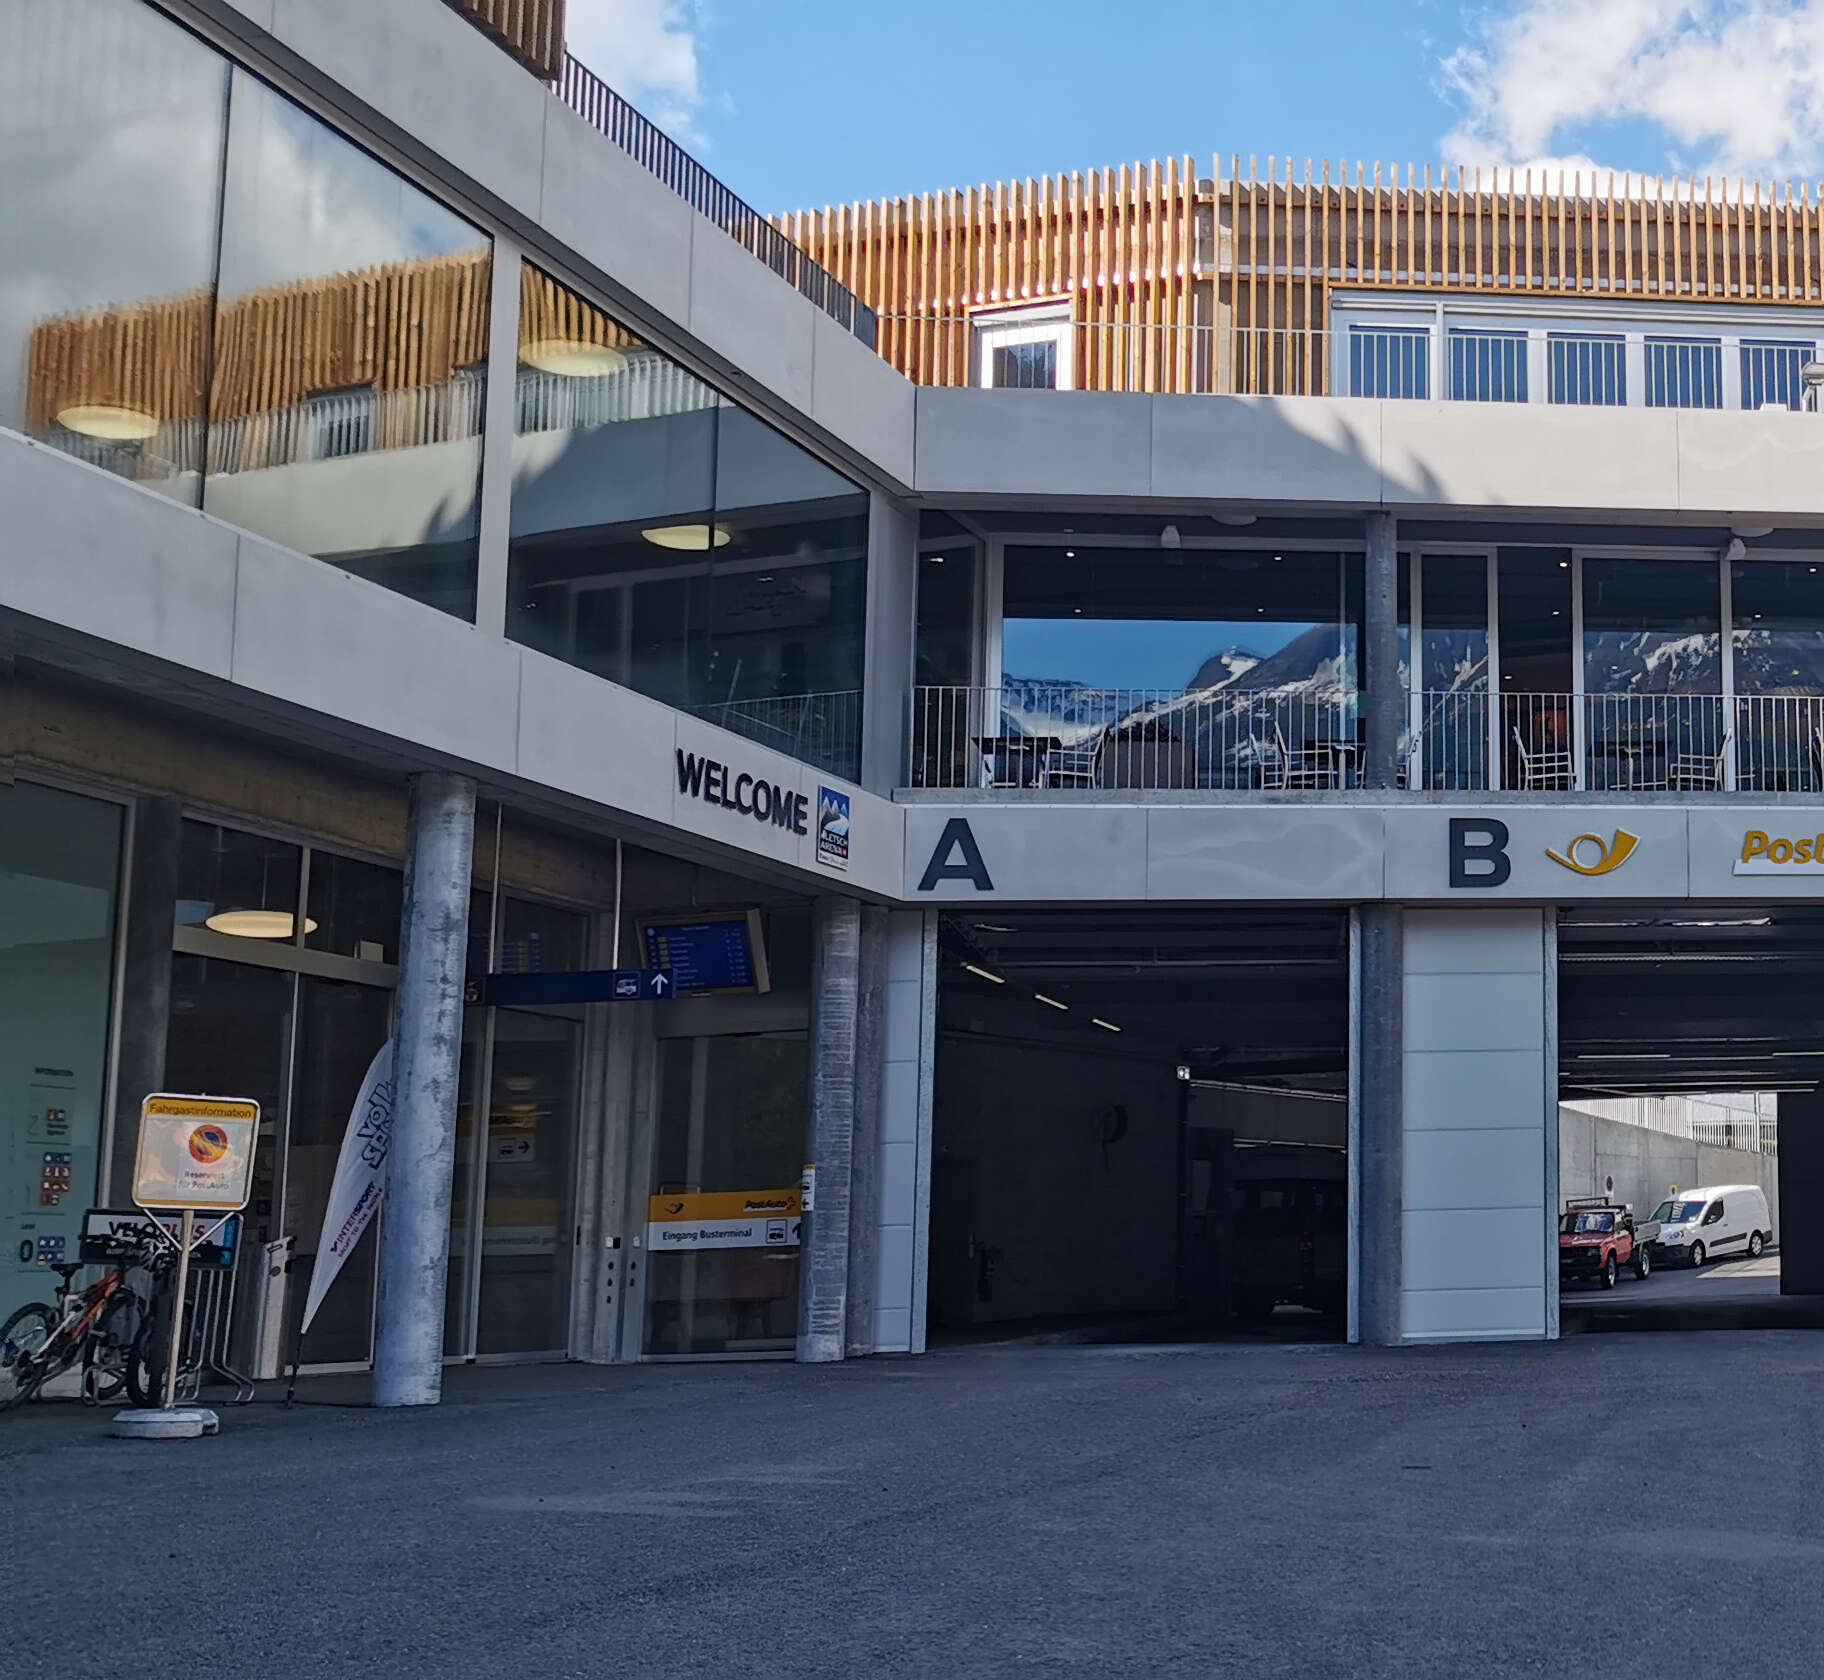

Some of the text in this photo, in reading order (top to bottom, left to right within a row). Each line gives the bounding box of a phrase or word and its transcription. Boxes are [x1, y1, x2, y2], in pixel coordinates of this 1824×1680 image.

[676, 748, 809, 837] WELCOME
[918, 817, 995, 891] A
[1449, 818, 1511, 888] B
[149, 1102, 252, 1119] Fahrgastinformation
[335, 1180, 377, 1245] INTERSPORT
[662, 1227, 753, 1242] Eingang Busterminal
